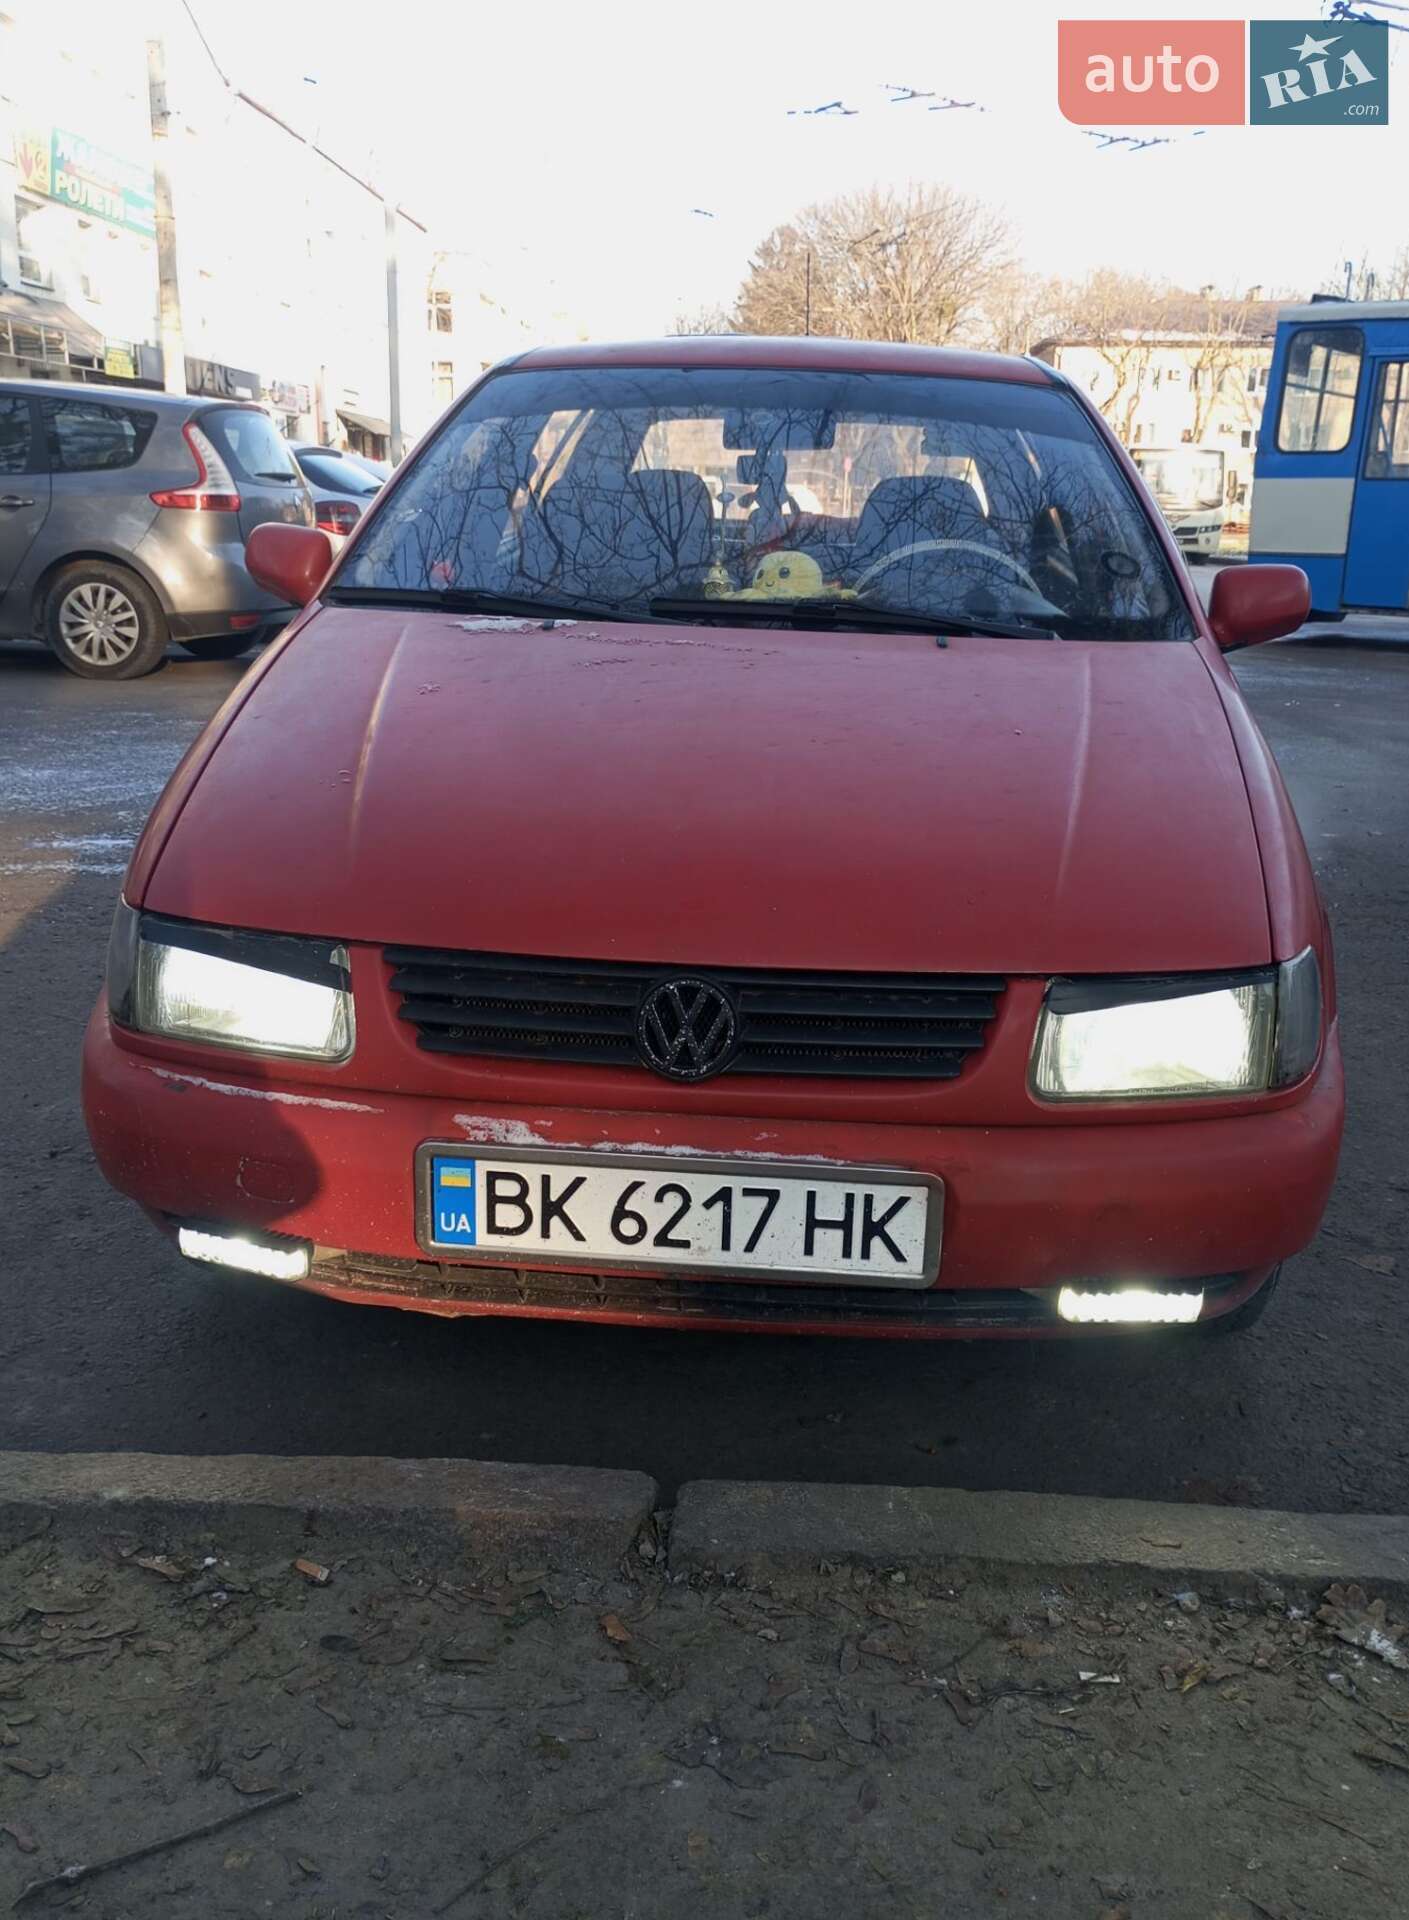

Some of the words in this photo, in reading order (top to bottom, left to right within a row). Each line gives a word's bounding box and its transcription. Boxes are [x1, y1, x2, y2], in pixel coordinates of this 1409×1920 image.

[440, 1212, 472, 1234] UA
[485, 1170, 588, 1242] BK
[610, 1180, 781, 1253] 6217
[803, 1190, 912, 1263] HK
